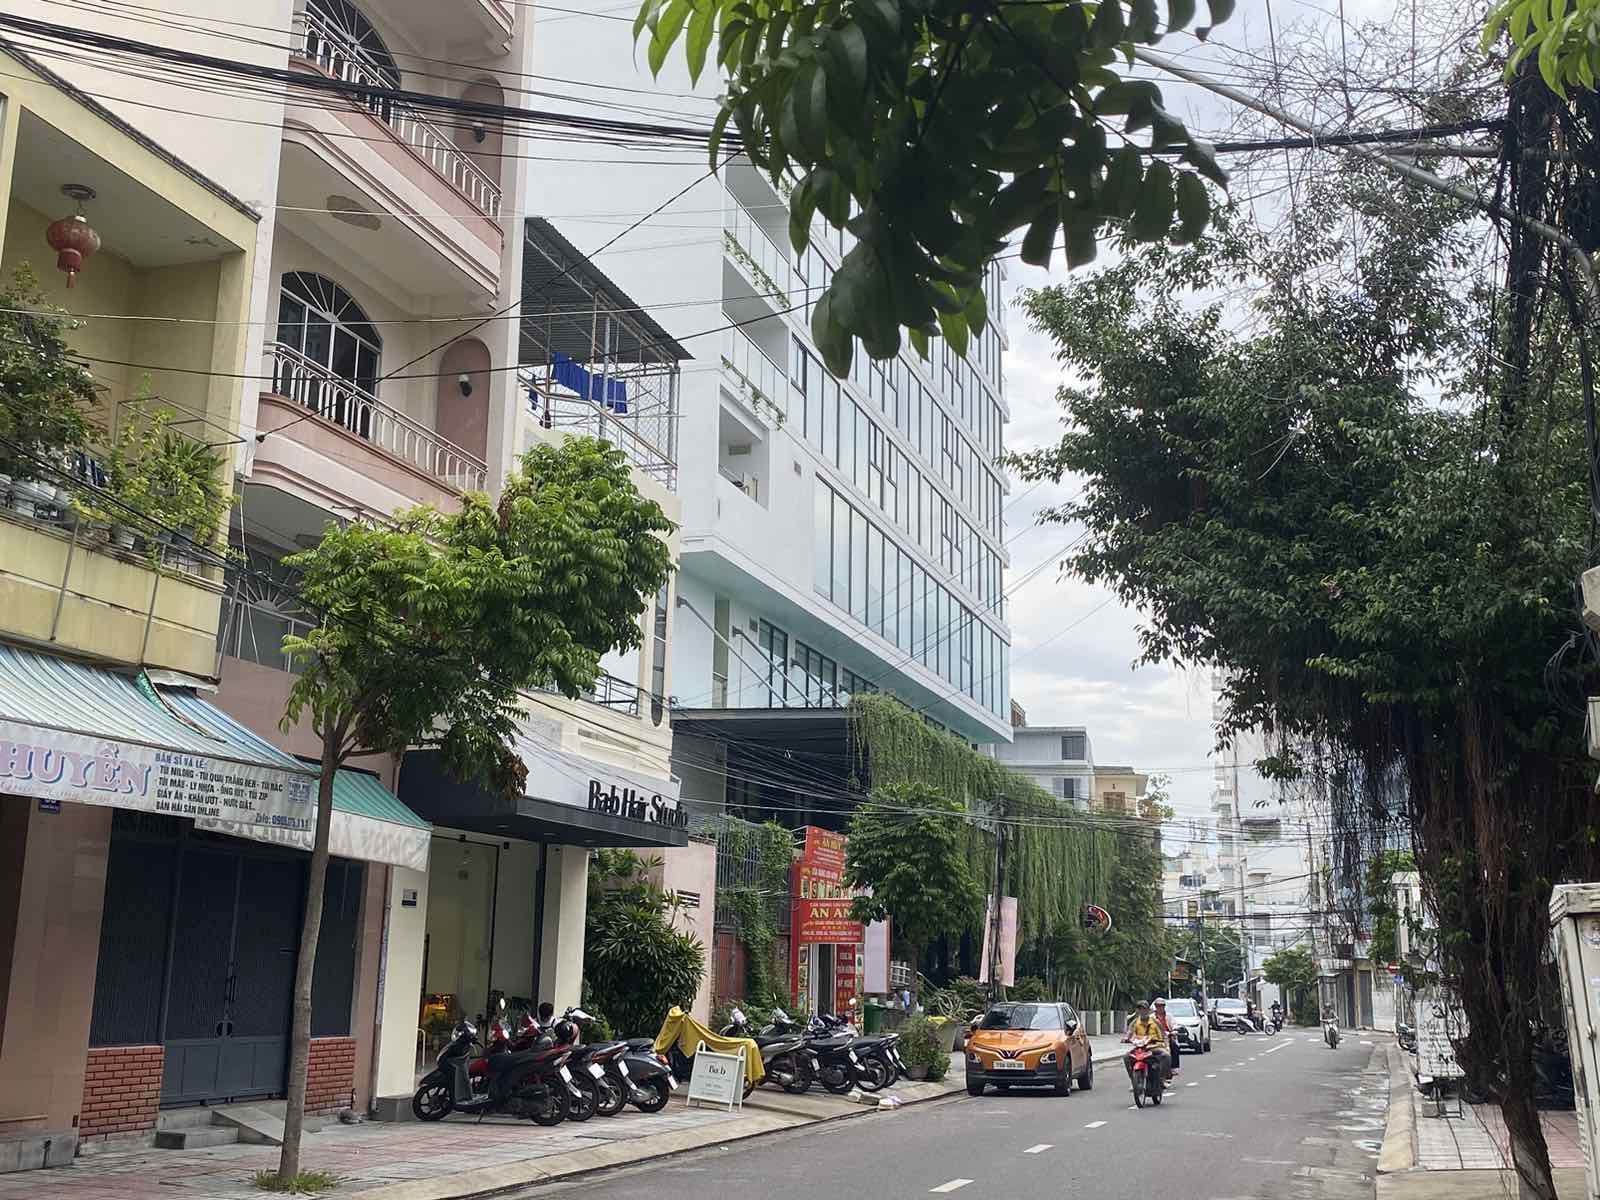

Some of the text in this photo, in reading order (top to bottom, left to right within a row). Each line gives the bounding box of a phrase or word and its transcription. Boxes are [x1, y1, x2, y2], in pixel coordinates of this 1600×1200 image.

[258, 792, 268, 801] ZIP
[197, 805, 220, 817] ONLINE
[621, 787, 649, 822] Hair
[649, 794, 689, 829] Studio
